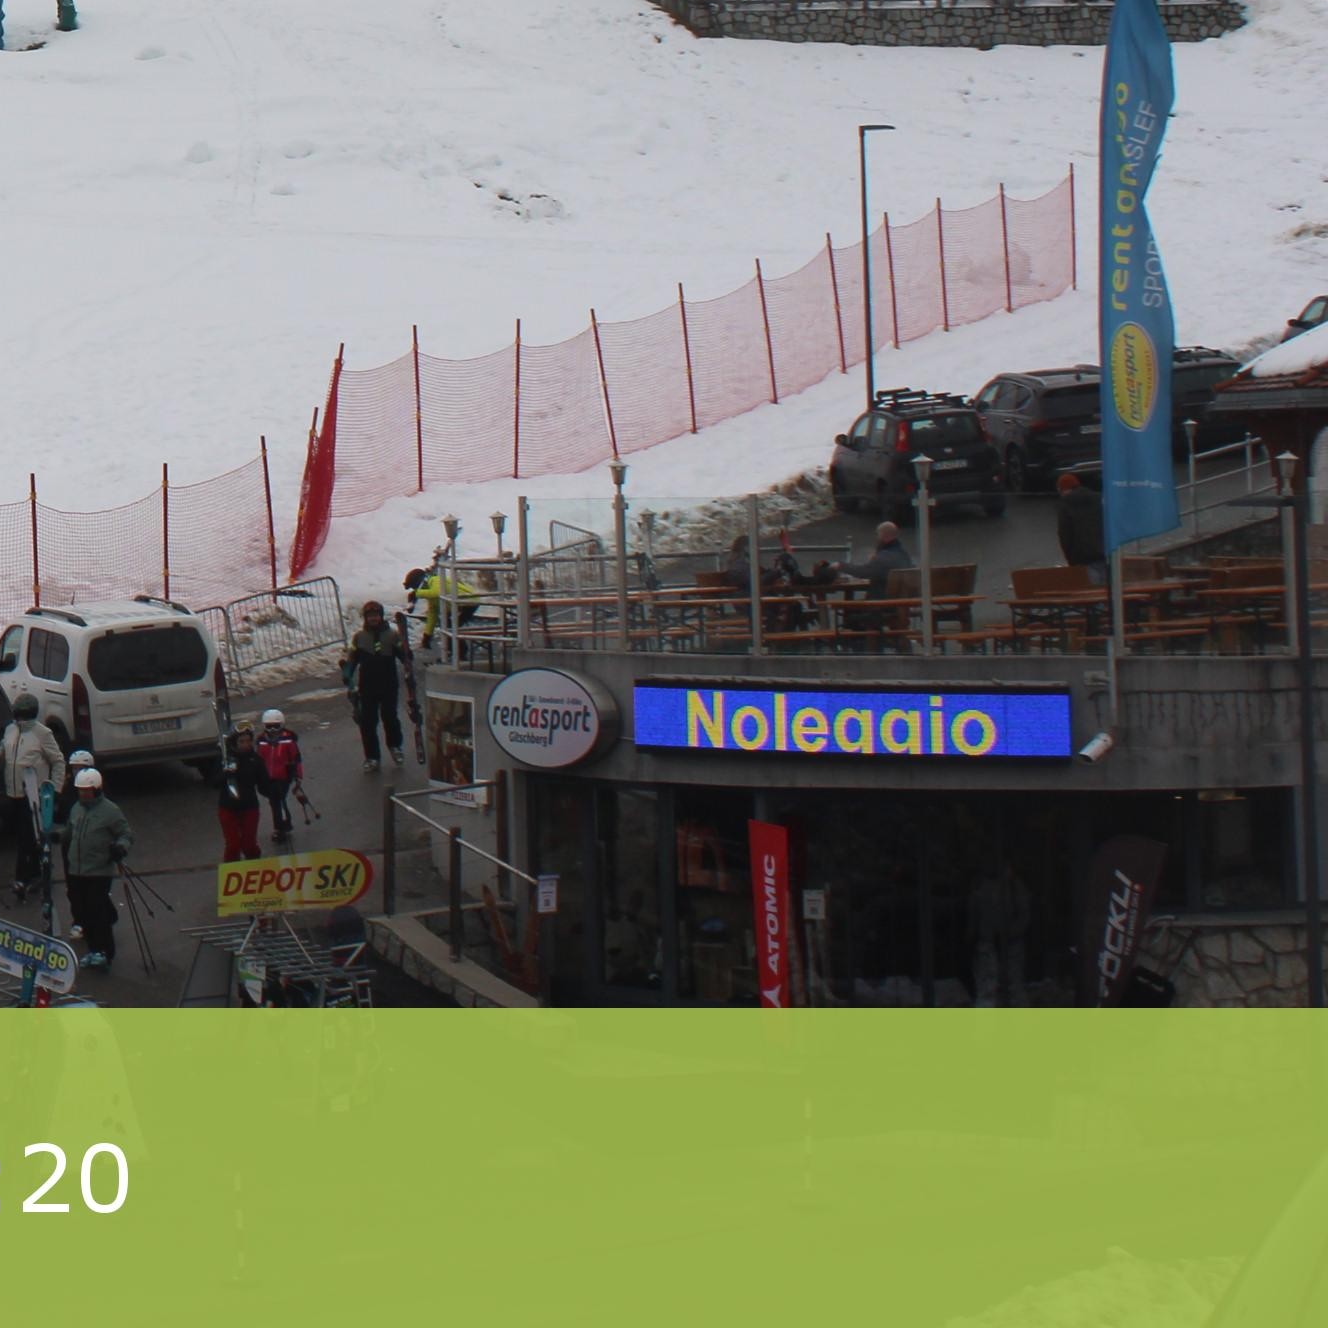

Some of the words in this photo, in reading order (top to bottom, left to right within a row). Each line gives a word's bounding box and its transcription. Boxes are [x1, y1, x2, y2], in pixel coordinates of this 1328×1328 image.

[1112, 224, 1134, 311] rent
[492, 695, 592, 745] rentasport
[508, 730, 548, 748] Gitschberg
[222, 866, 313, 897] DEPOT
[314, 862, 361, 891] SKI
[763, 853, 780, 976] ATOMIC
[1097, 868, 1134, 1004] TÖCKLI
[14, 938, 45, 961] and
[47, 951, 68, 970] go
